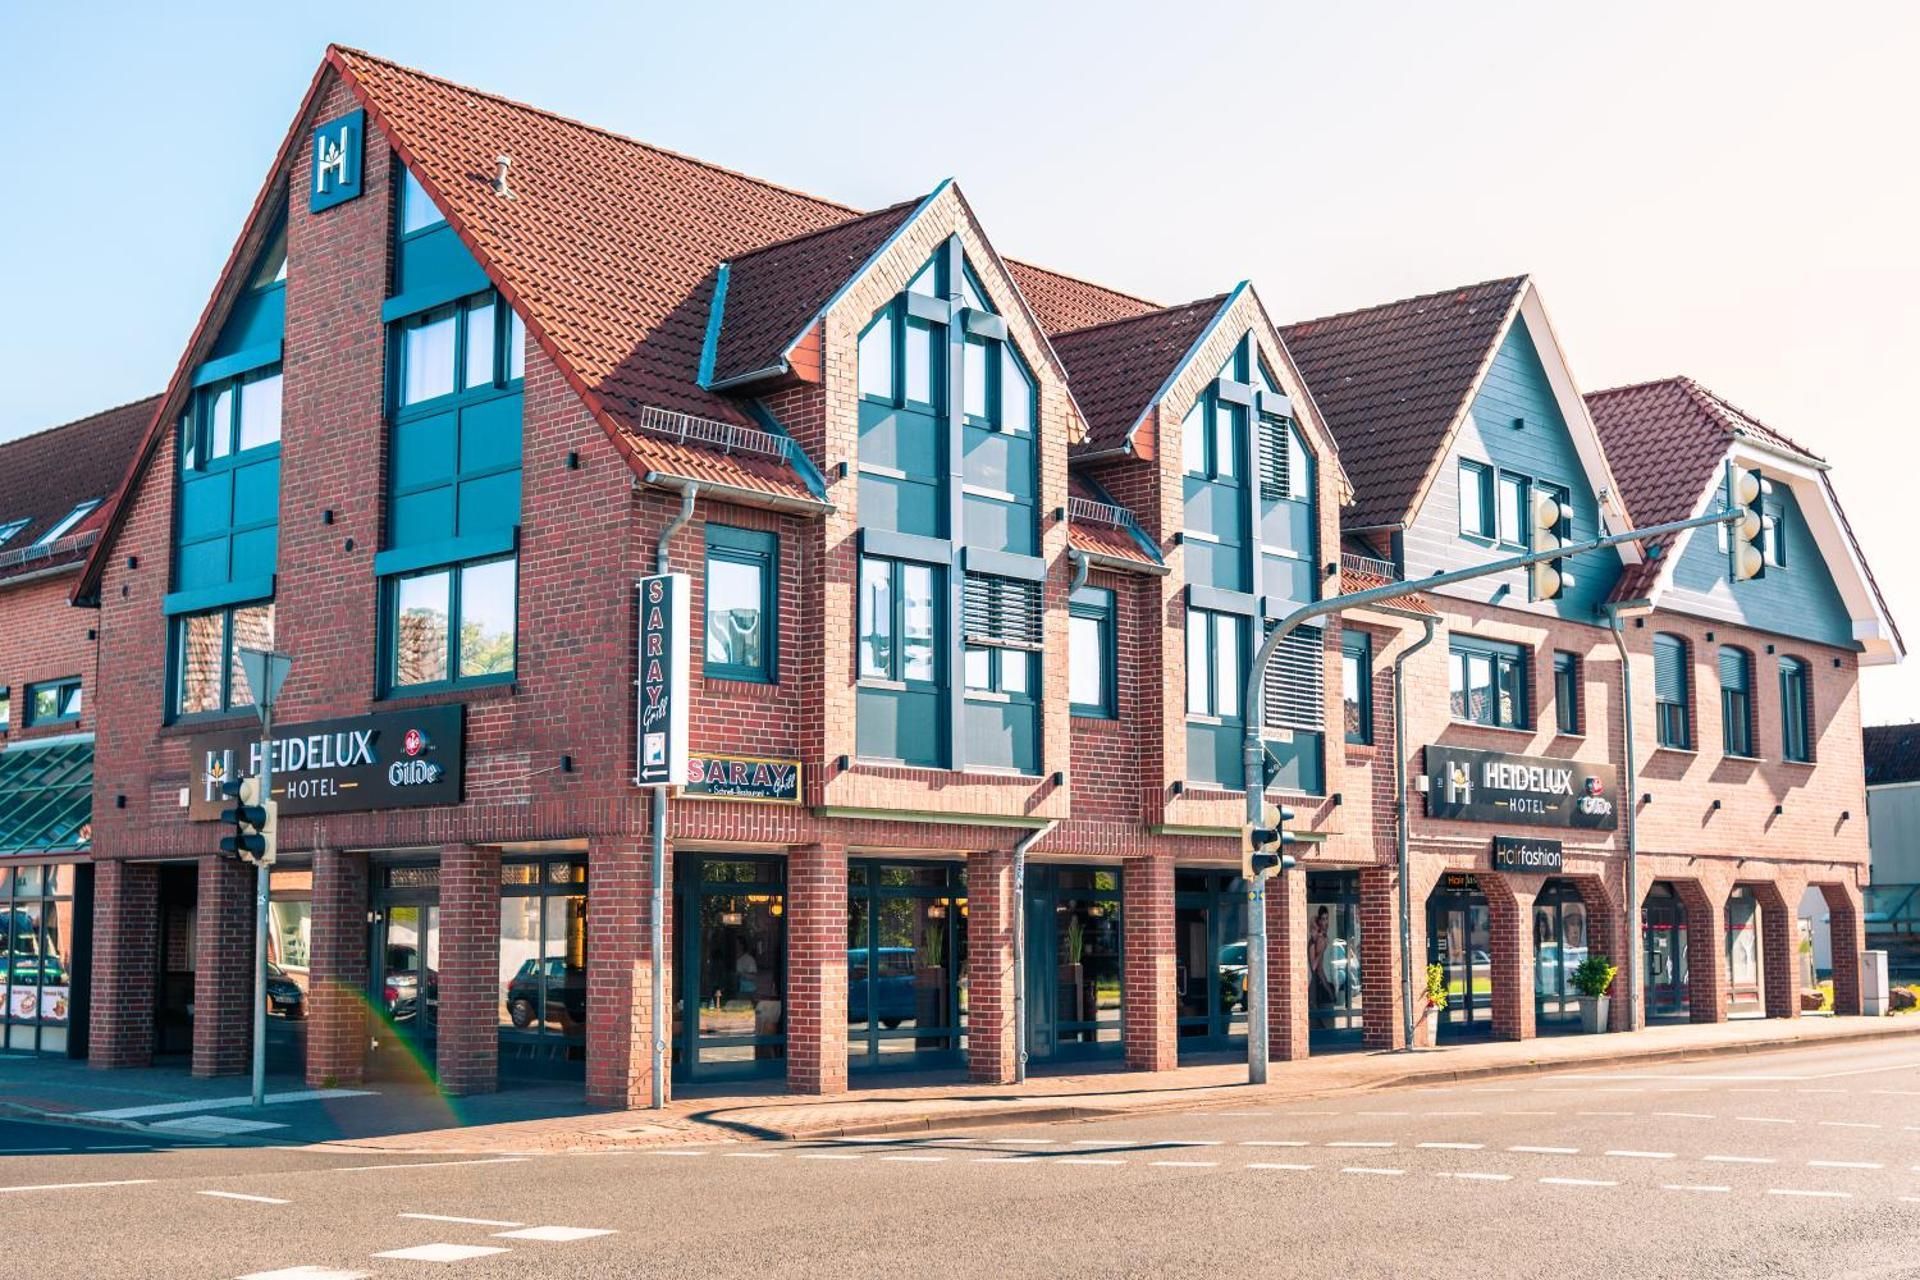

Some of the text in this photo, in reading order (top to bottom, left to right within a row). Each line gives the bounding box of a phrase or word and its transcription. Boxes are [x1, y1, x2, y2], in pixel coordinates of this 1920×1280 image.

[646, 579, 664, 708] SARAY
[643, 696, 669, 733] Grill
[250, 729, 373, 775] HEIDELUX
[687, 758, 791, 787] SARAY
[1485, 762, 1574, 796] HEIDELUX
[287, 778, 338, 799] HOTEL
[1509, 797, 1546, 814] HOTEL
[1497, 844, 1561, 867] Hairfashion
